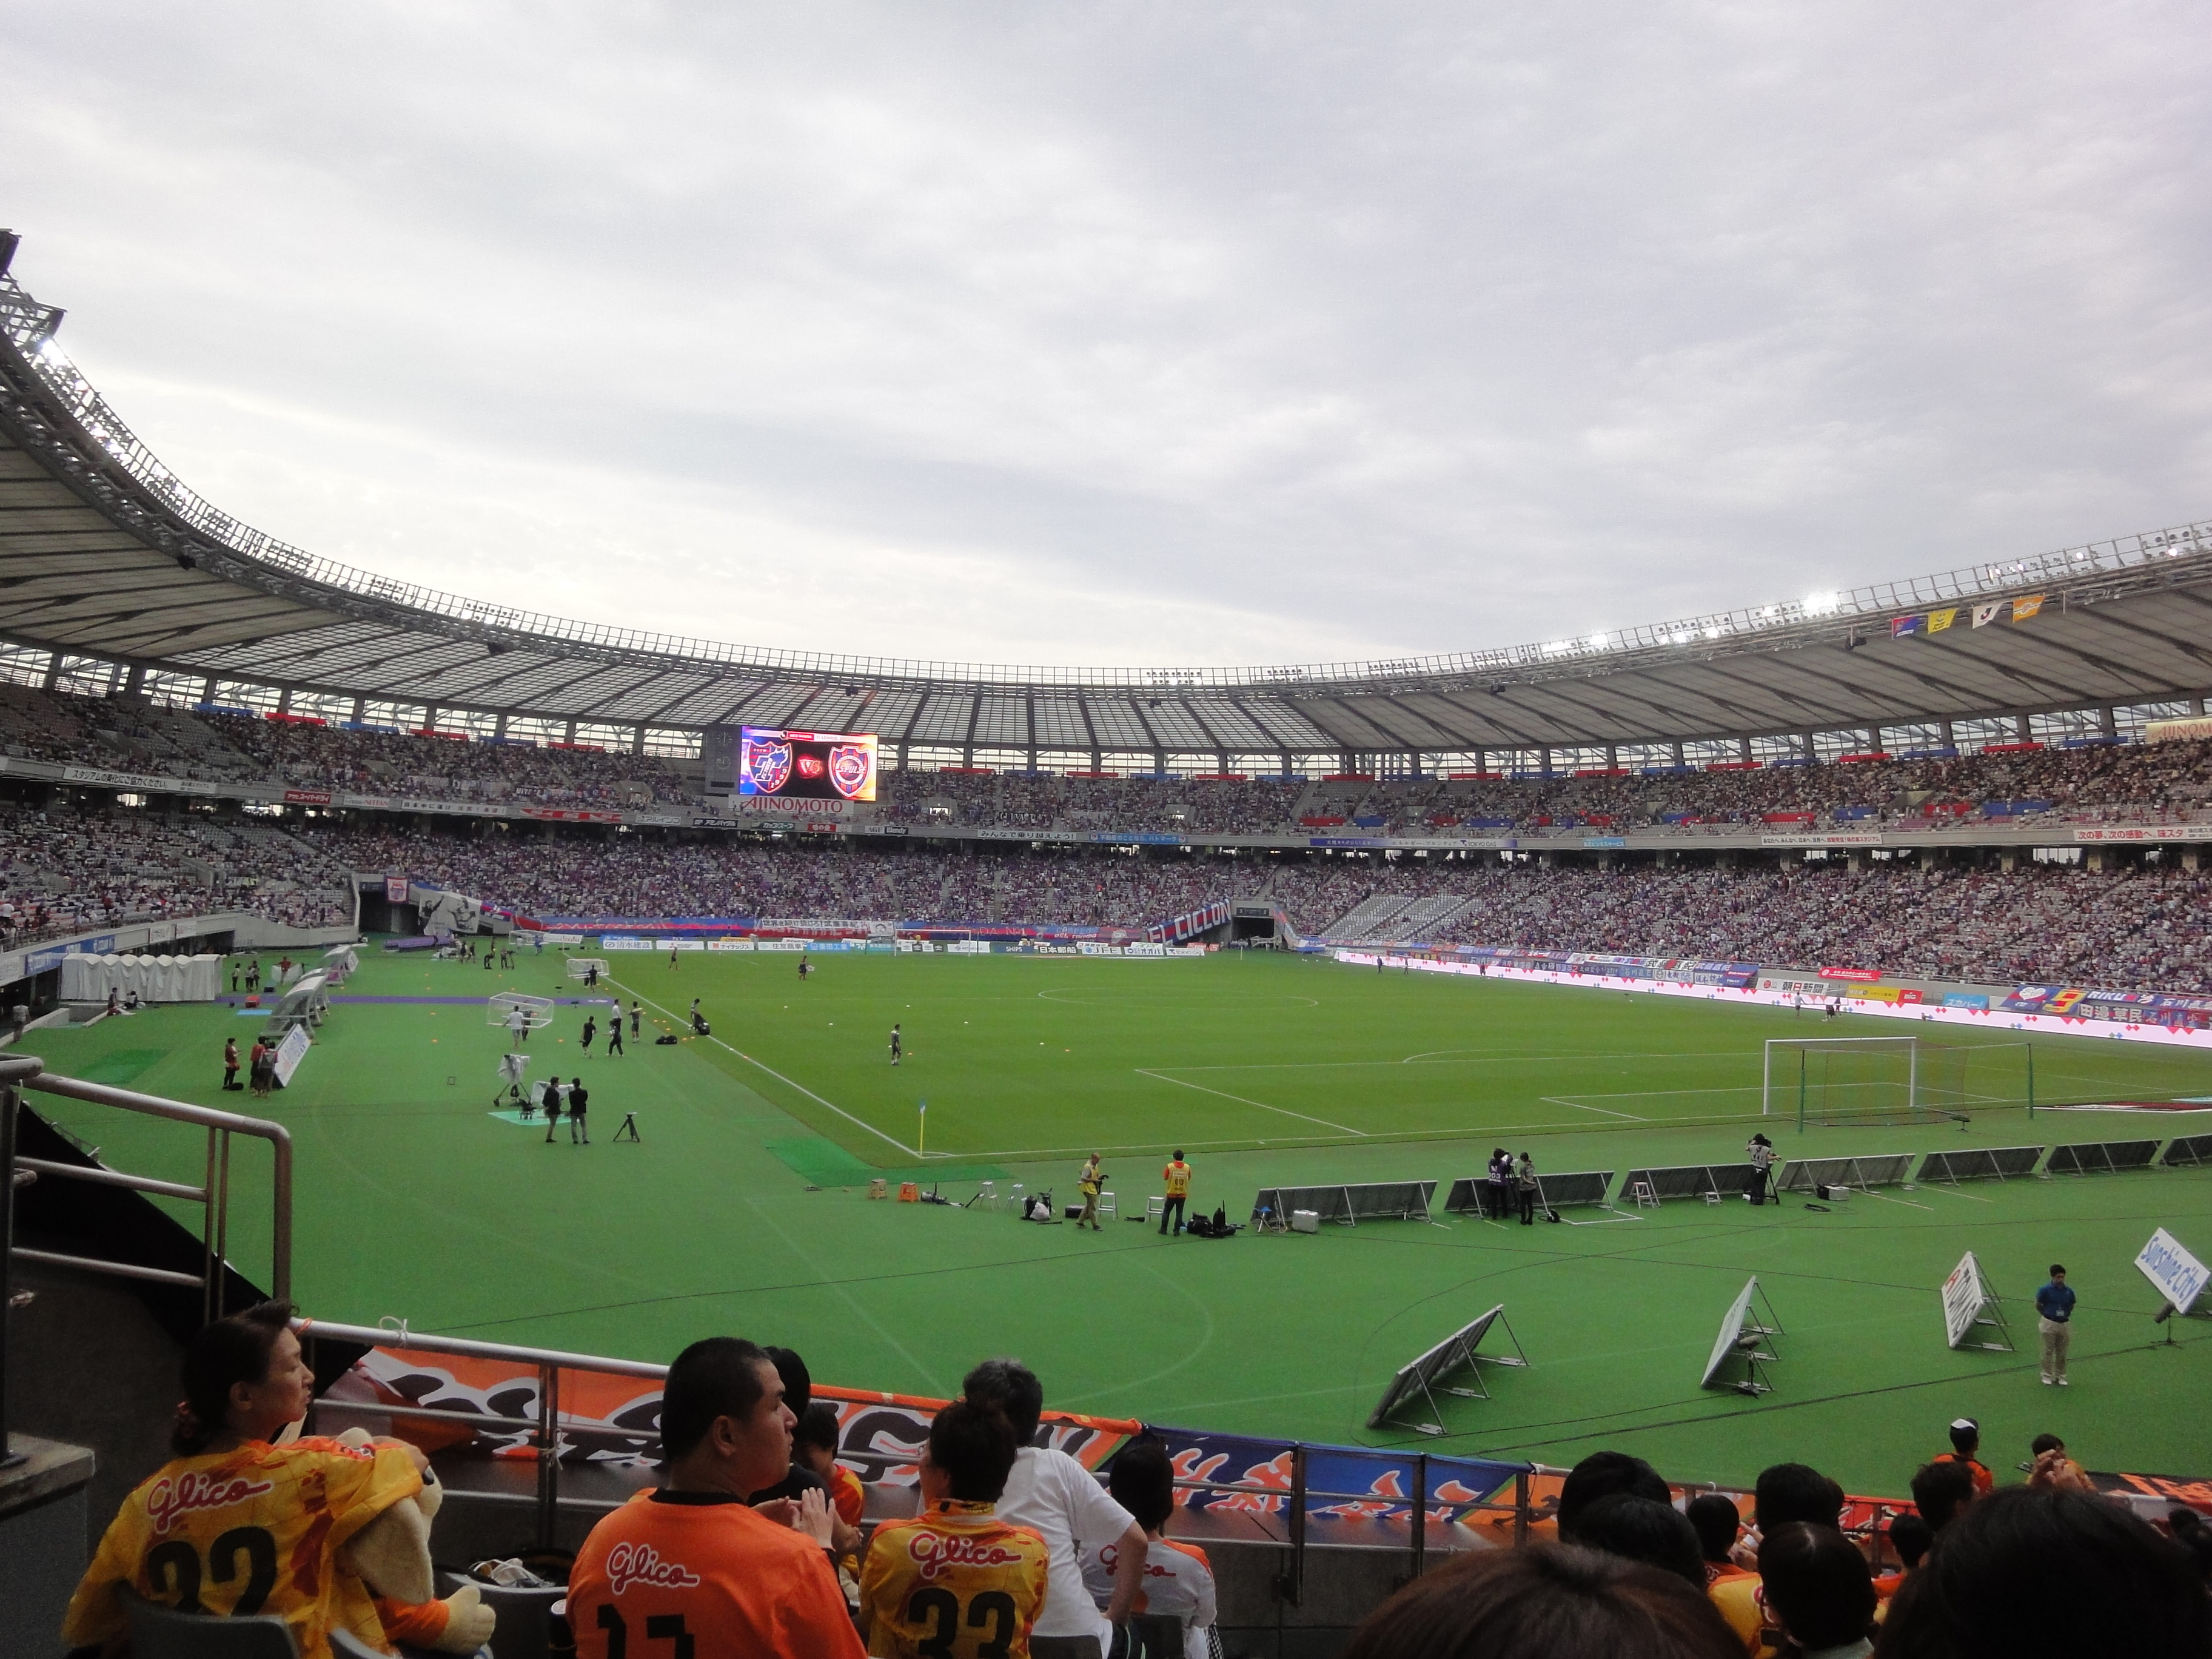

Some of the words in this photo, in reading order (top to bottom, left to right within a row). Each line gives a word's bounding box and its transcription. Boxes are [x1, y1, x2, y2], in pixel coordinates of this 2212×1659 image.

[799, 759, 822, 774] VS
[740, 796, 843, 813] AJINOMOTO
[1781, 981, 1825, 994] 朝日新聞
[2140, 1236, 2182, 1285] Sunshine
[2171, 1265, 2200, 1304] City
[147, 1473, 273, 1534] Glico
[607, 1541, 700, 1595] Glico
[909, 1532, 1023, 1579] Glico
[1099, 1544, 1177, 1577] Gco
